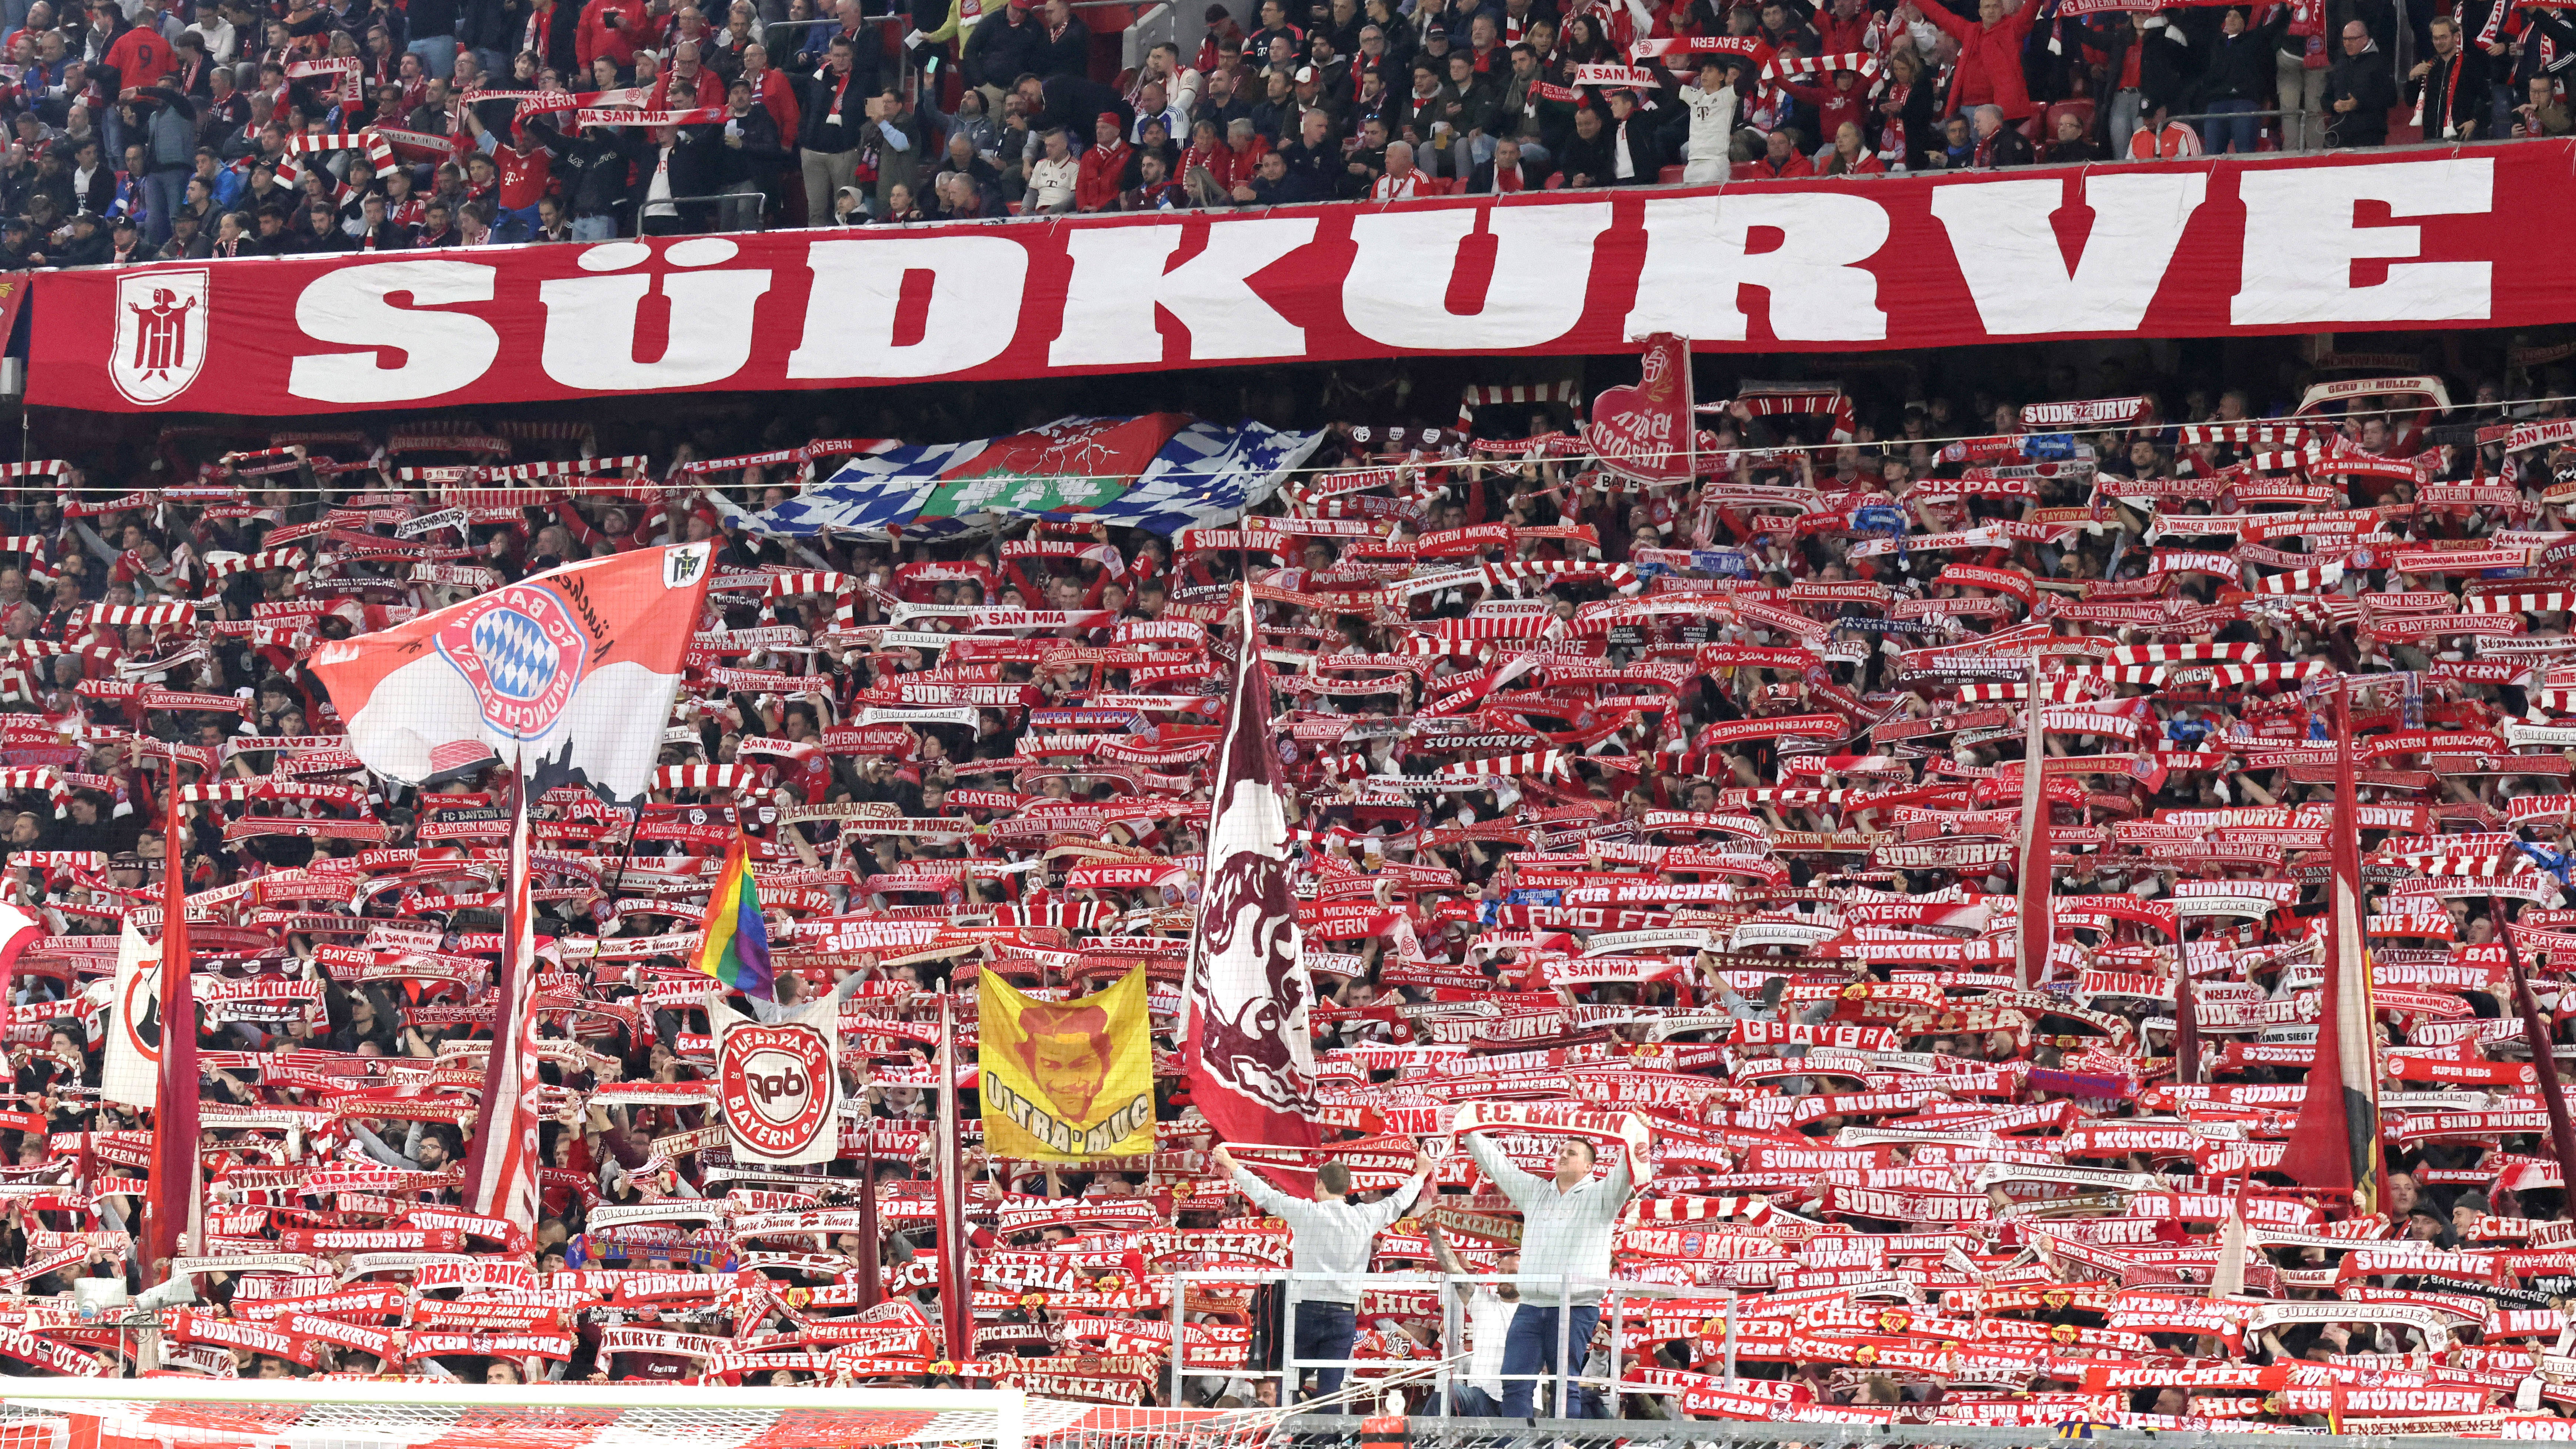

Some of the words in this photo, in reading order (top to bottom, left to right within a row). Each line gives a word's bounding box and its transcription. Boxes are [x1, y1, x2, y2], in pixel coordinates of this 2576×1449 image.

[1691, 37, 1740, 48] BAYERN
[1742, 39, 1756, 53] FC
[1594, 68, 1625, 80] SAN
[521, 94, 576, 114] BAYERN
[602, 110, 634, 123] SAN
[639, 111, 670, 123] MIA
[288, 157, 2493, 404] SÜDKURVE
[2328, 382, 2357, 393] GERD
[2025, 402, 2073, 423] SÜDK
[2076, 405, 2091, 416] 72
[2093, 398, 2141, 420] URVE
[2507, 427, 2538, 447] SAN
[2543, 422, 2573, 438] MIA
[2372, 463, 2412, 474] MÜNCHEN
[2102, 482, 2117, 492] FC
[2120, 482, 2161, 492] BAYERN
[2165, 480, 2218, 492] MÜNCHEN
[2427, 488, 2471, 501] BAYERN
[2170, 523, 2204, 531] IMMER
[2208, 522, 2238, 532] VORW
[2264, 524, 2302, 537] BAYERN
[2306, 521, 2356, 534] MÜNCHEN
[1419, 530, 1460, 549] BAYERN
[1002, 541, 1037, 555] SAN
[1041, 541, 1076, 554] MIA
[2402, 555, 2457, 568] MÜNCHEN
[2460, 553, 2501, 564] BAYERN
[1479, 604, 1495, 613] FC
[1497, 604, 1544, 613] BAYERN
[2074, 606, 2121, 618] BAYERN
[989, 613, 1026, 625] SAN
[1032, 612, 1066, 624] MIA
[2399, 619, 2452, 633] BAYERN
[2454, 617, 2517, 631] MÜNCHEN
[1495, 640, 1525, 653] 110
[1530, 641, 1587, 655] JAHRE
[2052, 640, 2085, 654] niemand
[1326, 656, 1373, 666] BAYERN
[1376, 656, 1427, 670] MÜNCHEN
[1707, 648, 1735, 662] Mia
[1737, 652, 1770, 664] san
[1772, 650, 1805, 665] mia
[925, 670, 955, 682] SAN
[958, 667, 985, 679] MIA
[1961, 670, 2022, 680] MÜNCHEN
[150, 694, 191, 704] BAYERN
[900, 681, 955, 705] SÜDK
[972, 686, 1021, 703] URVE
[1079, 711, 1131, 724] BAYERN
[2040, 711, 2138, 737] SÜDKURVE
[823, 731, 861, 746] BAYERN
[864, 729, 908, 746] MÜNCHEN
[1293, 725, 1346, 736] MÜNCHEN
[1714, 721, 1773, 739] MÜNCHEN
[2514, 728, 2567, 740] SÜDKURVE
[236, 737, 316, 749] BAYERN
[319, 736, 342, 748] FC
[742, 739, 771, 750] SAN
[773, 741, 792, 751] MIA
[1424, 734, 1538, 748] SÜDKURVE
[2375, 738, 2426, 751] BAYERN
[2432, 735, 2496, 749] MÜNCHEN
[2166, 754, 2201, 768] MIA
[959, 794, 1016, 807] BAYERN
[423, 825, 438, 835] FC
[440, 824, 476, 833] BAYERN
[642, 823, 687, 837] München
[1547, 829, 1587, 847] BAYERN
[1774, 833, 1822, 844] BAYERN
[2225, 832, 2238, 843] FC
[2239, 833, 2275, 843] BAYERN
[2277, 833, 2321, 845] MÜNCHEN
[364, 850, 417, 864] BAYERN
[1876, 845, 1933, 865] SÜDK
[1958, 843, 2013, 864] URVE
[638, 858, 665, 868] MIA
[1669, 853, 1683, 865] FC
[1684, 855, 1725, 868] BAYERN
[1727, 858, 1778, 876] MÜNCHEN
[801, 871, 846, 884] MÜNCHEN
[2473, 876, 2539, 889] MÜNCHEN
[228, 883, 244, 896] OF
[1335, 880, 1375, 893] BAYERN
[1566, 886, 1610, 905] FÜR
[1619, 883, 1731, 901] MÜNCHEN
[413, 895, 445, 909] SAN
[453, 894, 483, 906] MIA
[2103, 897, 2143, 910] FINAL
[1527, 907, 1604, 927] AMO
[1618, 909, 1672, 928] FC
[1849, 905, 1922, 924] BAYERN
[2409, 915, 2449, 934] 1972
[385, 933, 410, 944] SAN
[413, 936, 434, 947] MIA
[1735, 927, 1787, 941] SÜDKURVE
[1840, 943, 1960, 960] SÜDKURVE
[1568, 965, 1604, 976] SAN
[1609, 965, 1638, 976] MIA
[2373, 965, 2489, 986] SÜDKURVE
[648, 982, 685, 996] SAN
[688, 980, 722, 994] MIA
[839, 1017, 940, 1044] MÜNCHEN
[1511, 1016, 1562, 1039] URVE
[2287, 1031, 2314, 1042] SIEGT
[724, 1033, 821, 1066] QUEERPASS
[2431, 1065, 2463, 1077] SUPER
[2465, 1067, 2491, 1078] REDS
[1526, 1107, 1627, 1134] BAYERN
[2440, 1114, 2482, 1128] SIND
[1761, 1150, 1876, 1169] SÜDKURVE
[2006, 1165, 2072, 1179] SÜDKURVE
[2074, 1171, 2133, 1185] MÜNCHEN
[318, 1184, 357, 1193] BESTEN
[1926, 1197, 1989, 1220] URVE
[408, 1211, 509, 1240] SÜDKURVE
[2329, 1217, 2376, 1240] 1972
[313, 1230, 425, 1249] SÜDKURVE
[1846, 1236, 1885, 1251] SIND
[1888, 1233, 1964, 1250] MÜNCHEN
[2356, 1250, 2493, 1276] SÜDKURVE
[623, 1271, 740, 1300] SÜDKURVE
[419, 1299, 441, 1312] WIR
[443, 1302, 471, 1315] SIND
[473, 1304, 489, 1316] DIE
[490, 1305, 521, 1318] FANS
[522, 1306, 549, 1318] VON
[2278, 1306, 2357, 1318] SÜDKURVE
[2360, 1307, 2432, 1323] MÜNCHEN
[430, 1313, 476, 1327] BAYERN
[477, 1315, 533, 1329] MÜNCHEN
[189, 1318, 291, 1354] SÜDKURVE
[291, 1315, 389, 1352] SÜDKURVE
[494, 1333, 572, 1356] MÜNCHEN
[2106, 1368, 2261, 1387] MÜNCHEN
[2438, 1368, 2471, 1381] WIR
[2473, 1372, 2516, 1387] SIND
[2347, 1389, 2482, 1411] MÜNCHEN
